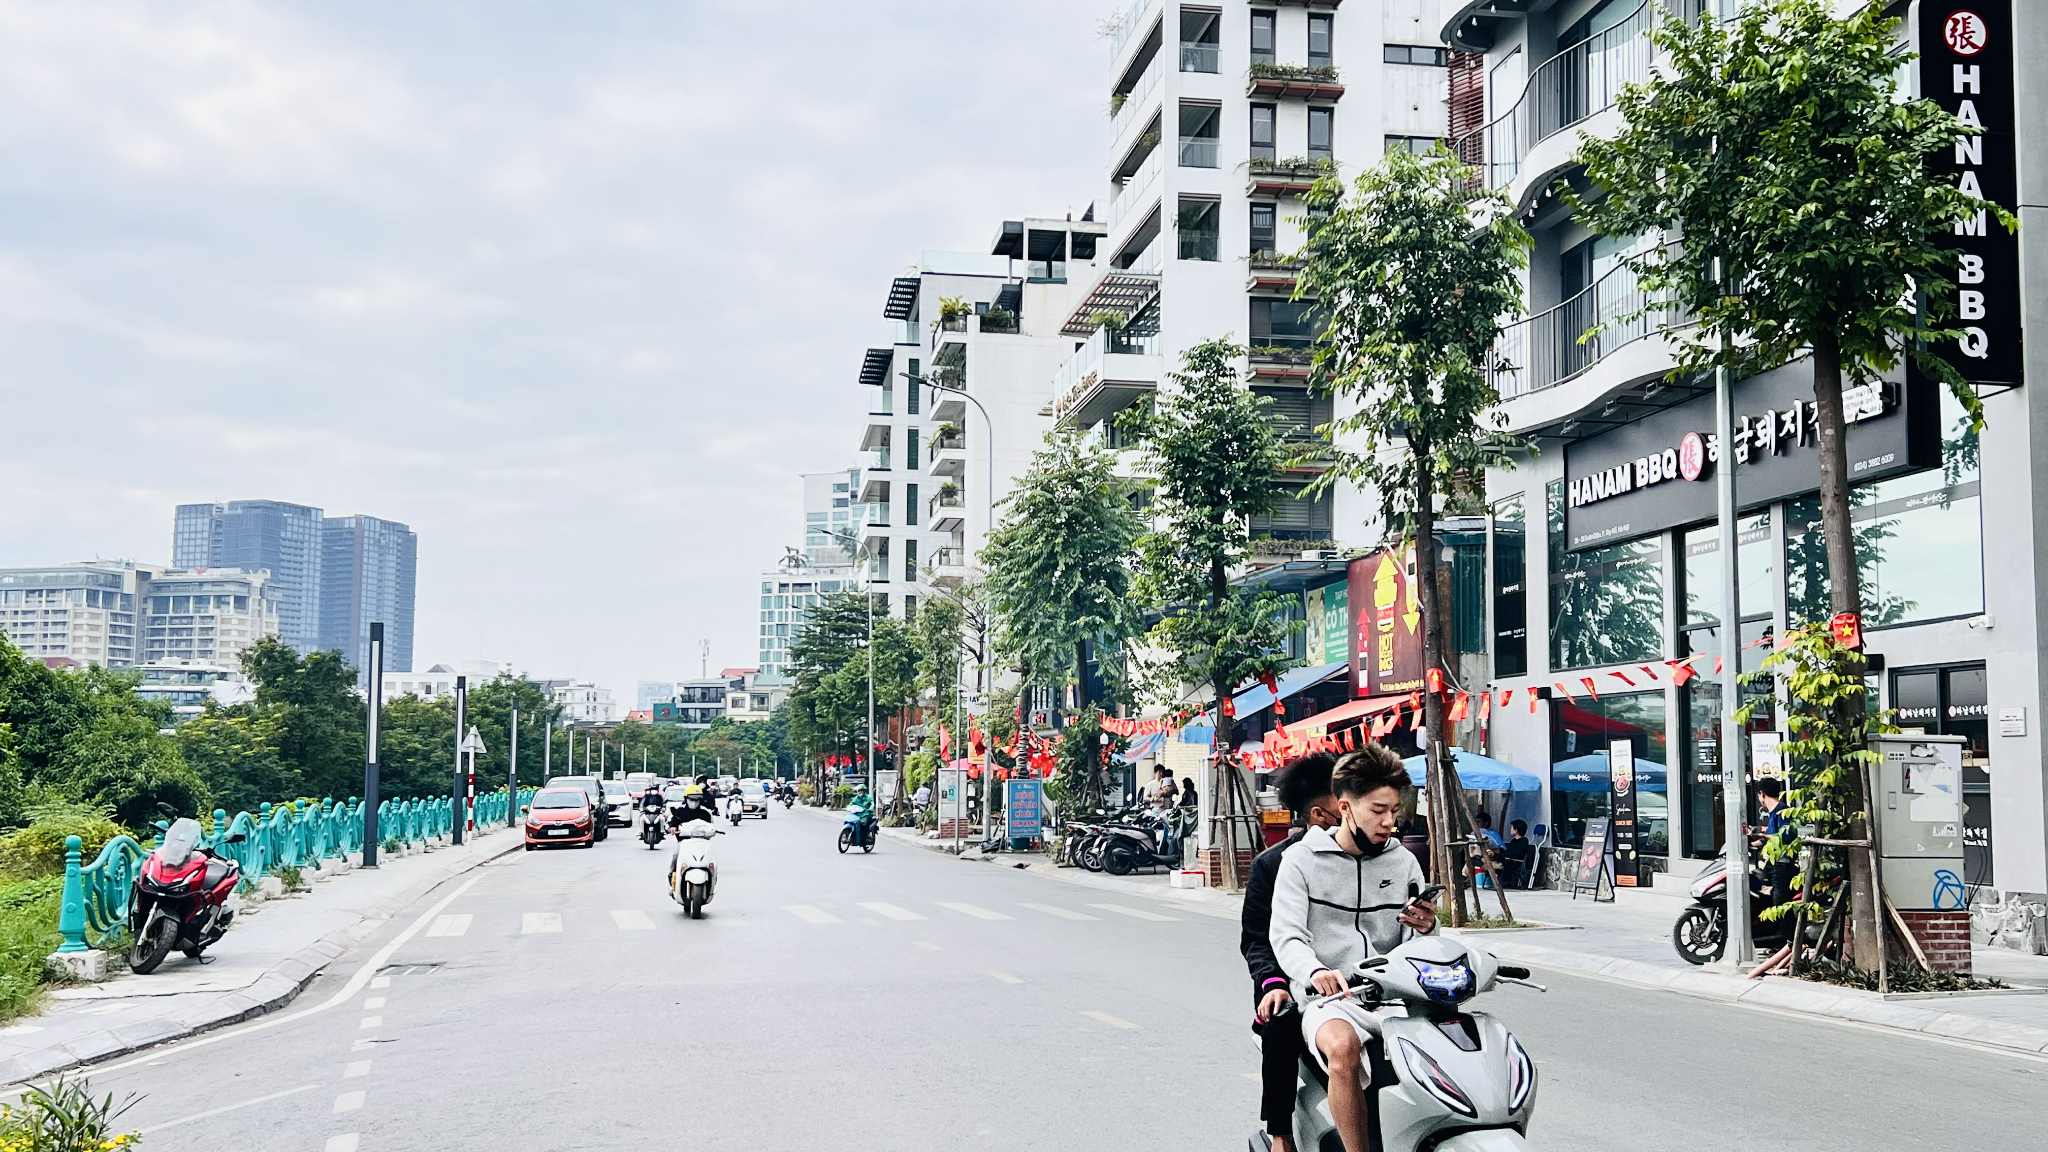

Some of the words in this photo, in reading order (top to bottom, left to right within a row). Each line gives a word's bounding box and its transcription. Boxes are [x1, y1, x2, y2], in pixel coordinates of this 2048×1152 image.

[1948, 15, 1982, 51] 張
[1952, 63, 1987, 237] HANAM
[1958, 254, 1989, 360] BBQ
[1568, 462, 1631, 508] HANAM
[1635, 447, 1678, 488] BBQ
